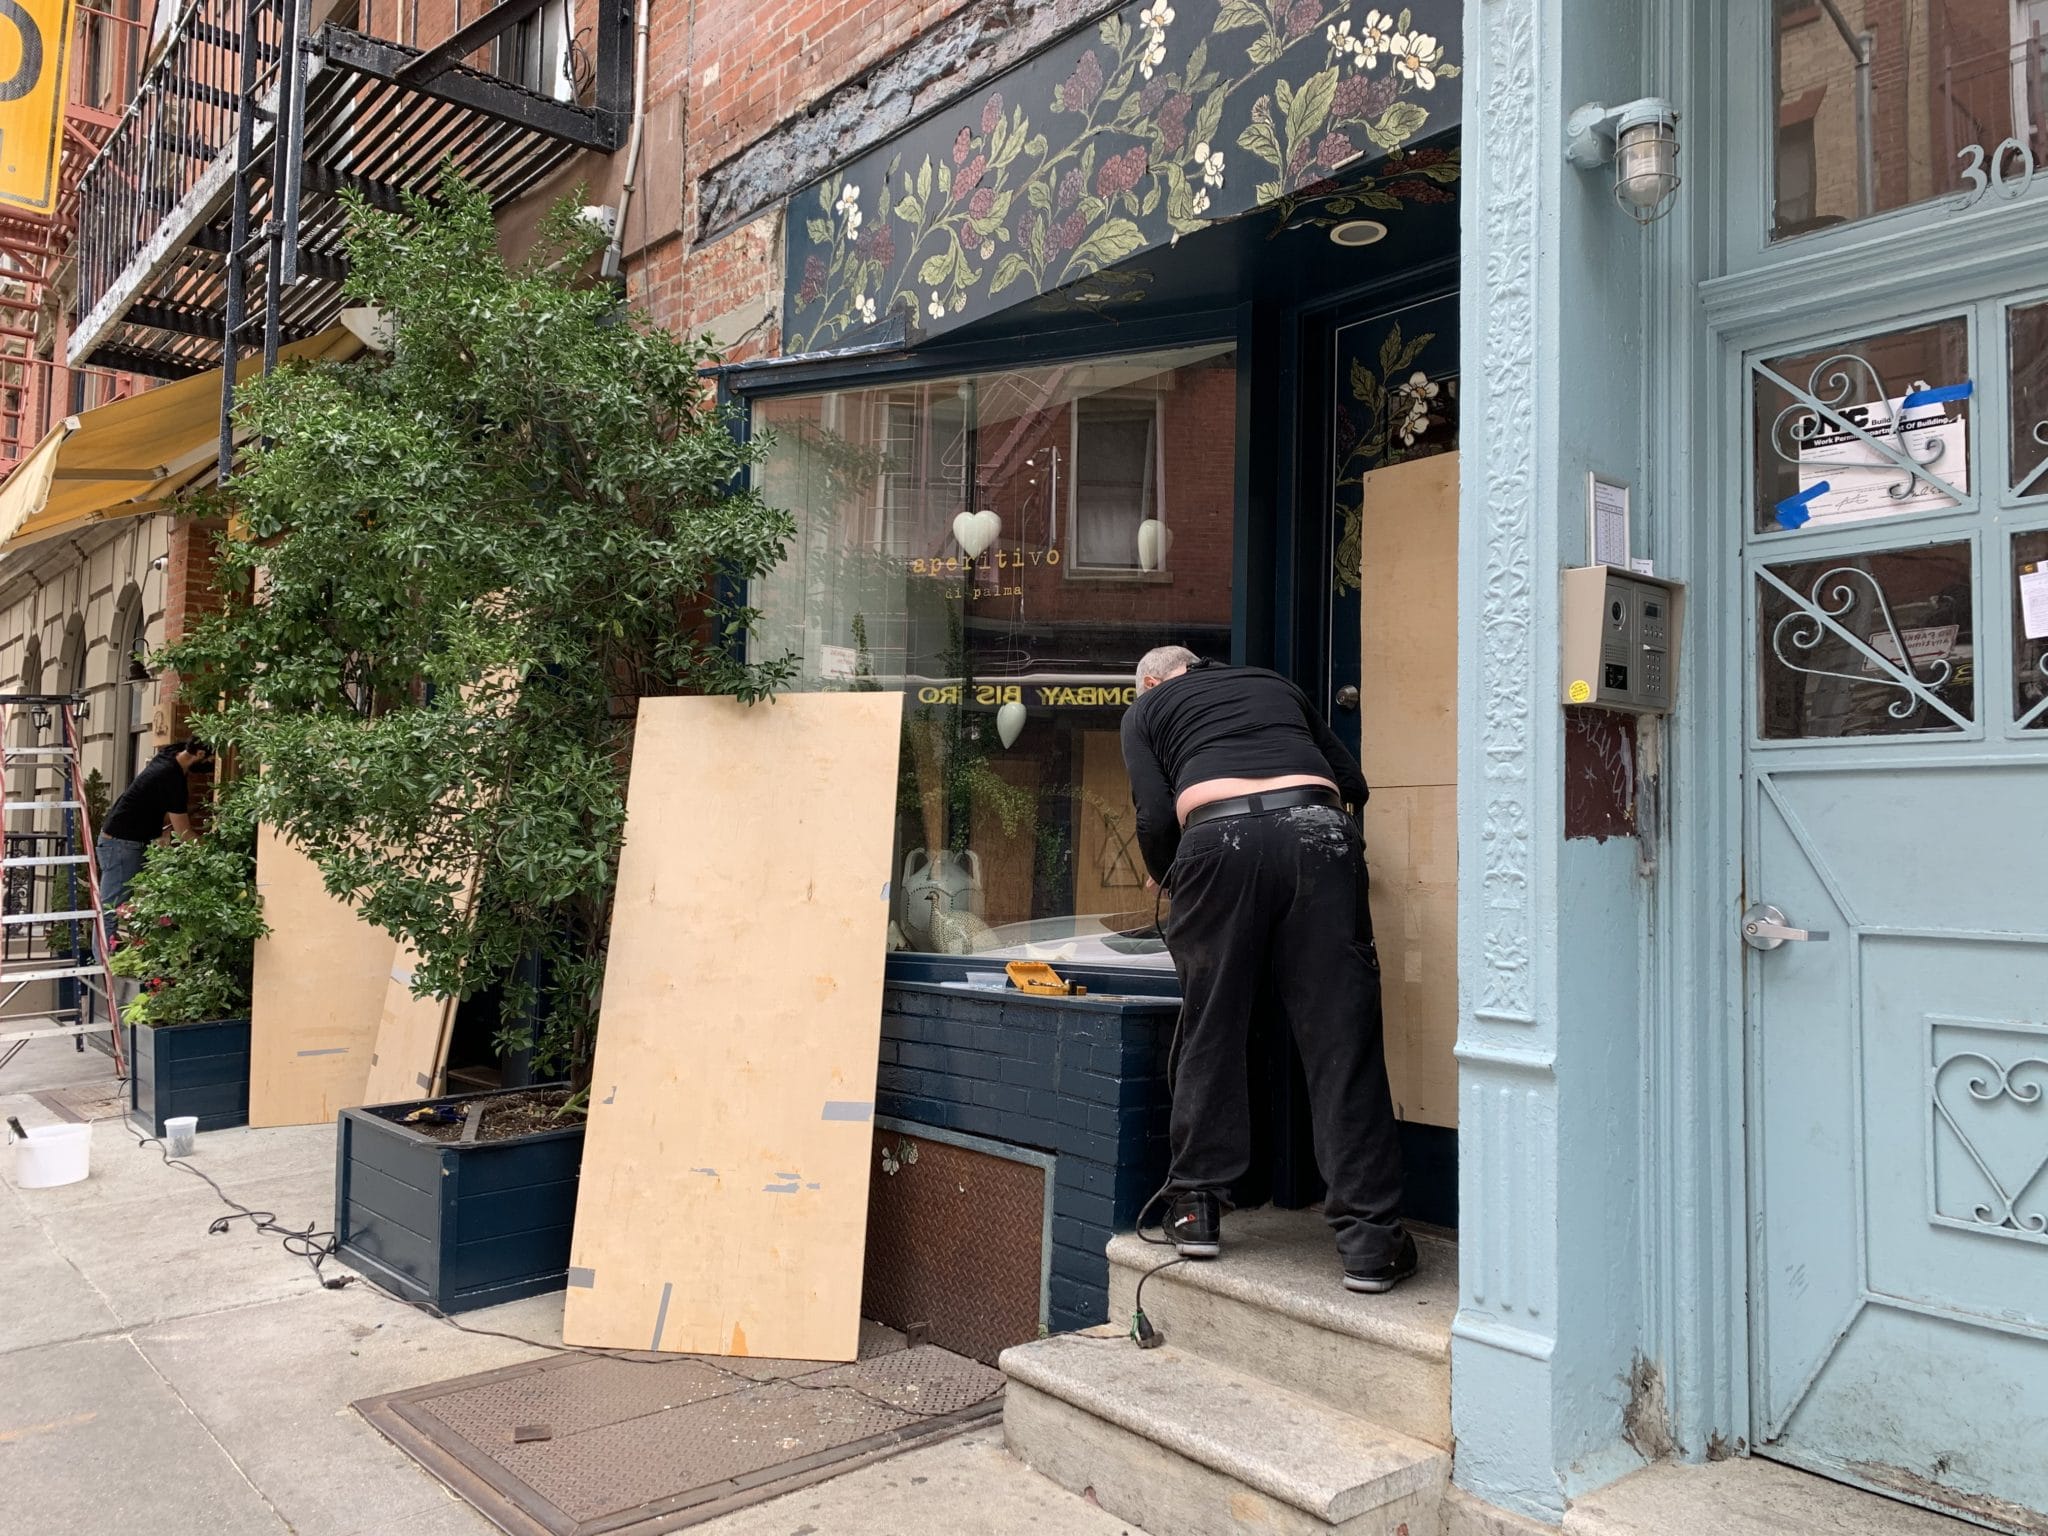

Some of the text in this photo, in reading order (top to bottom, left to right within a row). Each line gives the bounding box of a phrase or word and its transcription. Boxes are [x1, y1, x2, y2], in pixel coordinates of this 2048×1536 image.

[1949, 137, 2034, 212] 30
[1814, 437, 1834, 446] Work
[1834, 434, 1859, 443] Permi
[1906, 422, 1916, 430] Of
[912, 547, 1060, 577] aperitivo
[973, 585, 1022, 600] palma
